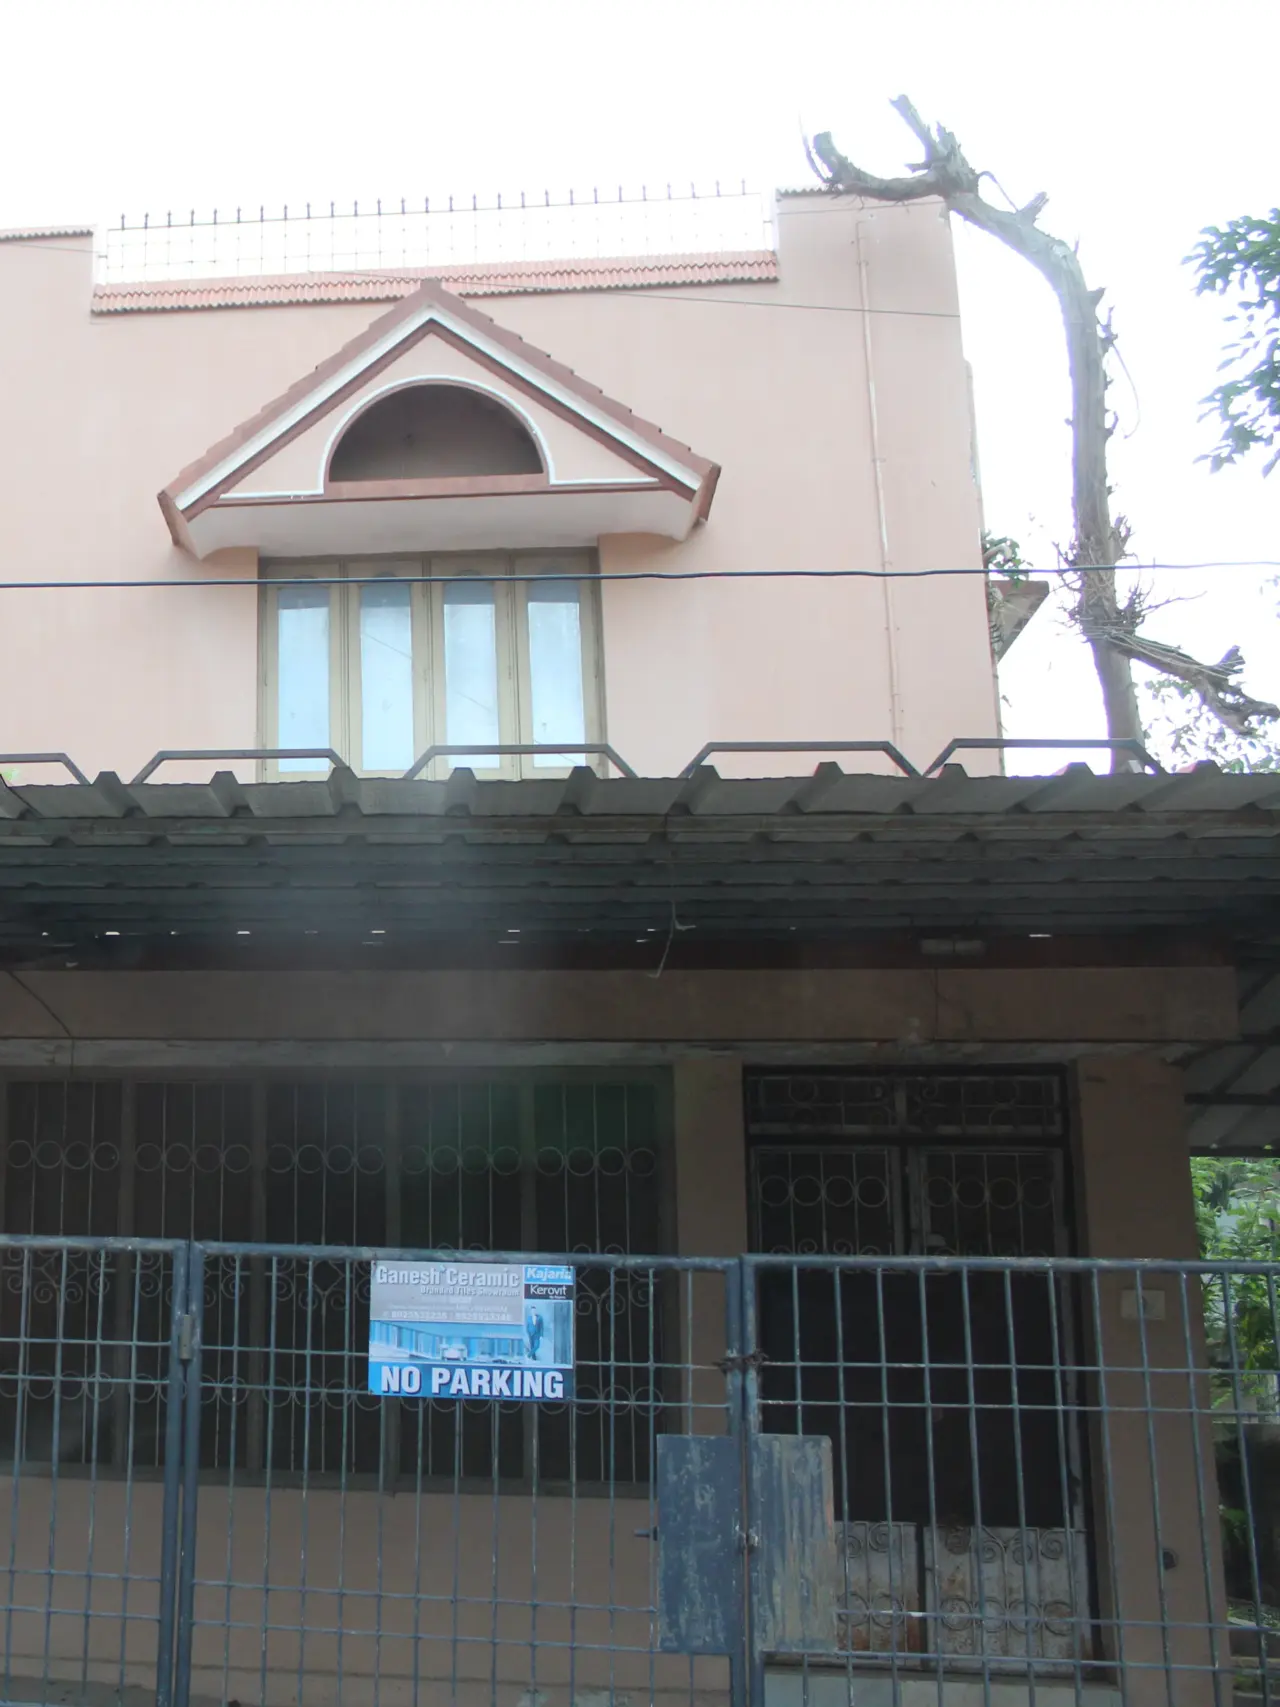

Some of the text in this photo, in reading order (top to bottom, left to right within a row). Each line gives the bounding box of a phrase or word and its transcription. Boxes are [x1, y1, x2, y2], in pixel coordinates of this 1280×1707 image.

[376, 1266, 520, 1288] Ganesh Ceramic
[527, 1267, 572, 1281] Kajaria
[530, 1284, 567, 1295] Kerovit
[381, 1365, 564, 1399] NO PARKING
